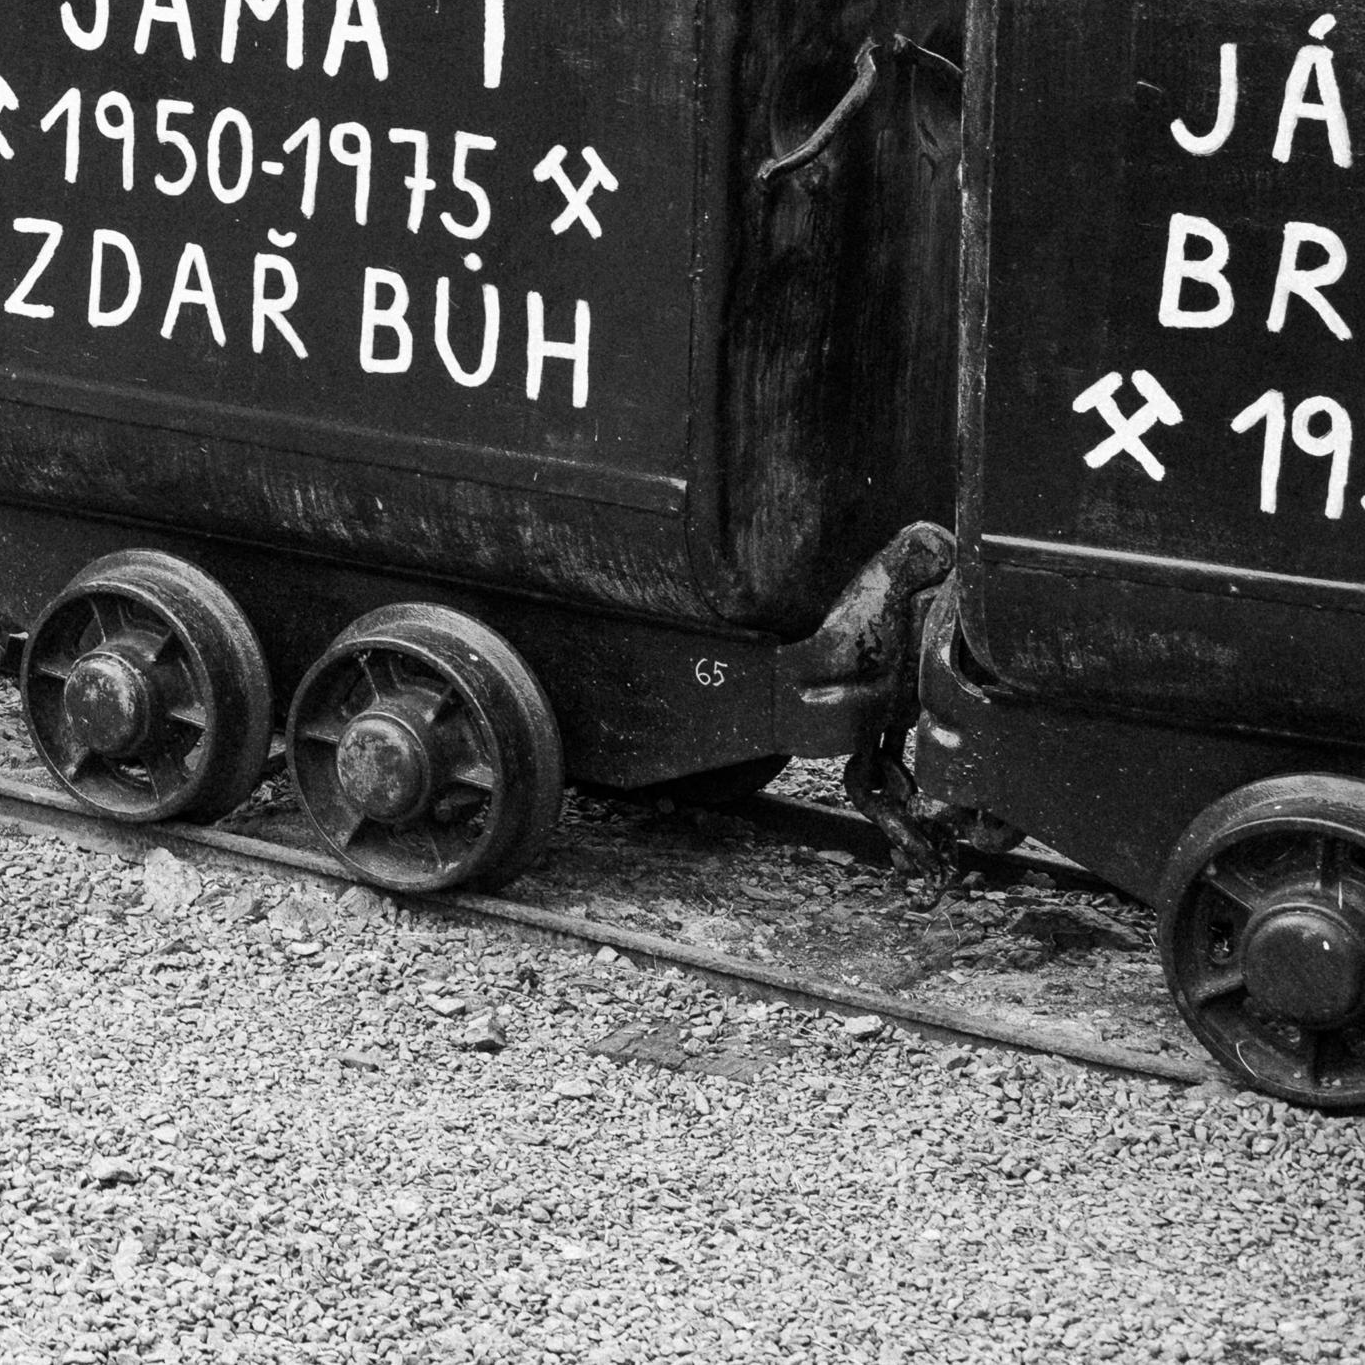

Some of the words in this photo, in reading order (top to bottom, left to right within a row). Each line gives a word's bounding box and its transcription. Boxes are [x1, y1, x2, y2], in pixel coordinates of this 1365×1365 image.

[40, 87, 497, 240] 1950-1975
[3, 217, 309, 359] ZDAŘ
[359, 252, 591, 409] BŮH
[695, 657, 728, 687] 65
